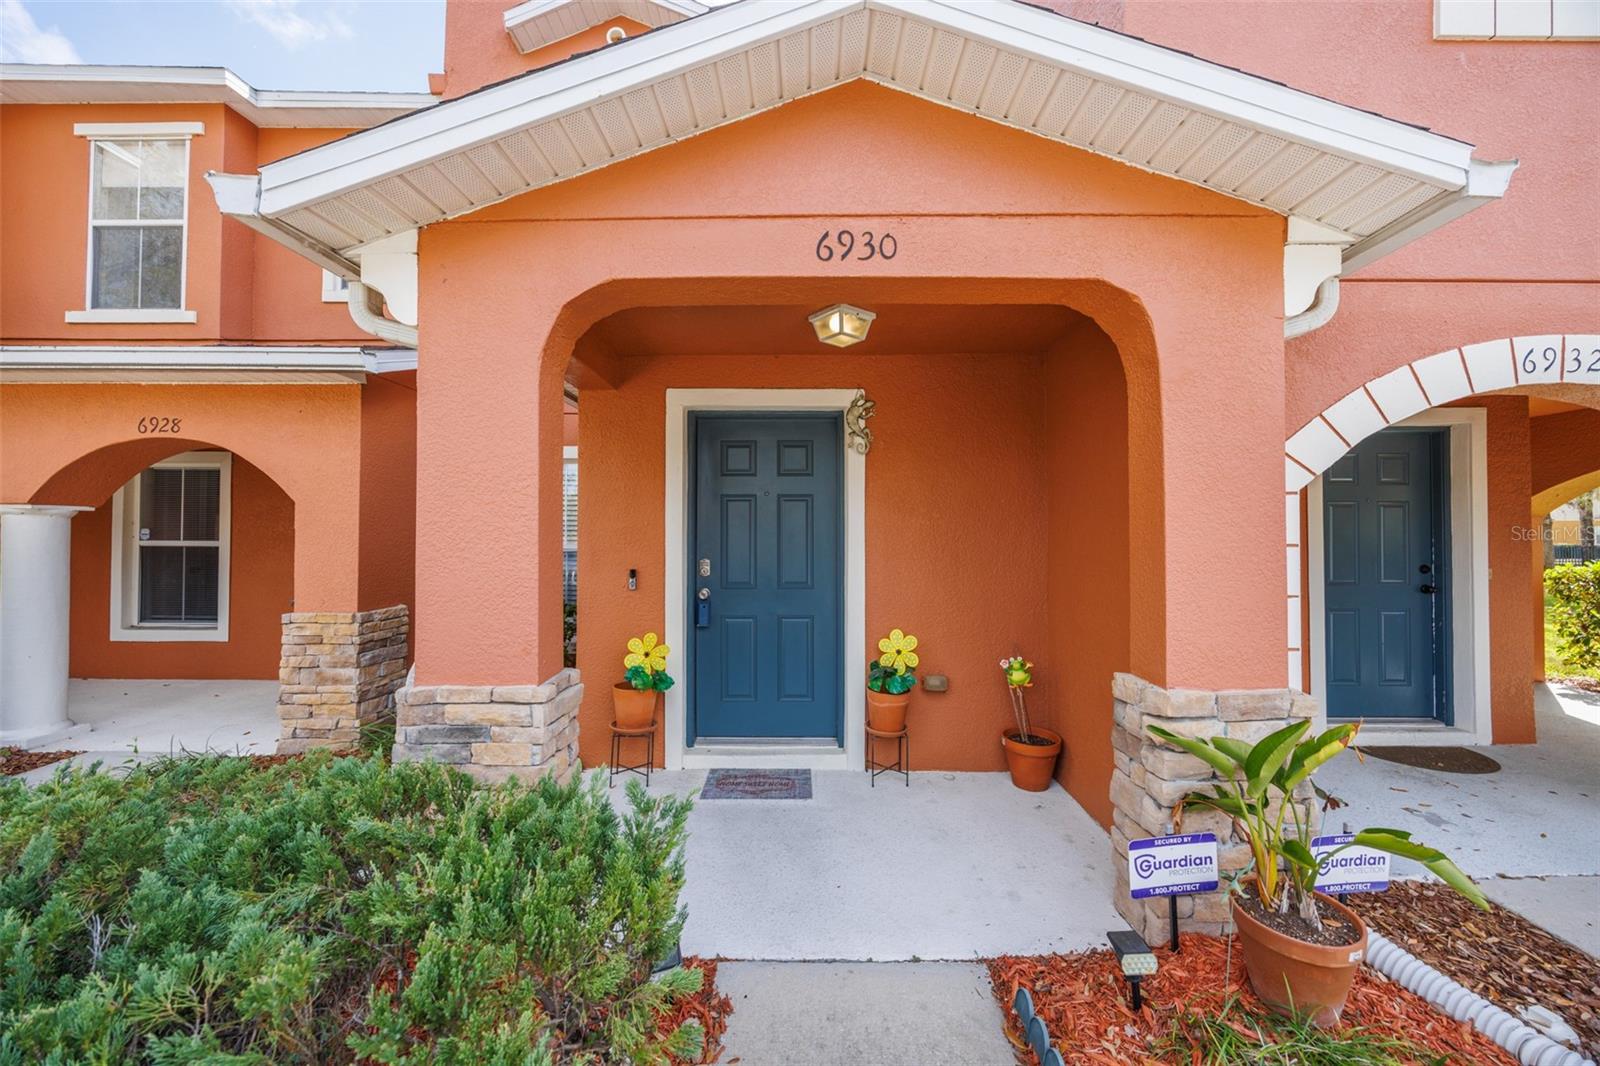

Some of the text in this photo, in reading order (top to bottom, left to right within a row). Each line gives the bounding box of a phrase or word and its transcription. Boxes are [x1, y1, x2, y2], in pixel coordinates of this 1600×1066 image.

[816, 230, 897, 261] 6930
[1522, 347, 1600, 374] 6932
[138, 416, 183, 434] 6928
[1154, 837, 1182, 846] SECURED
[1139, 854, 1213, 873] Guardian
[1169, 867, 1213, 876] PROTECTION
[1149, 884, 1200, 895] 1.800.PROTECT
